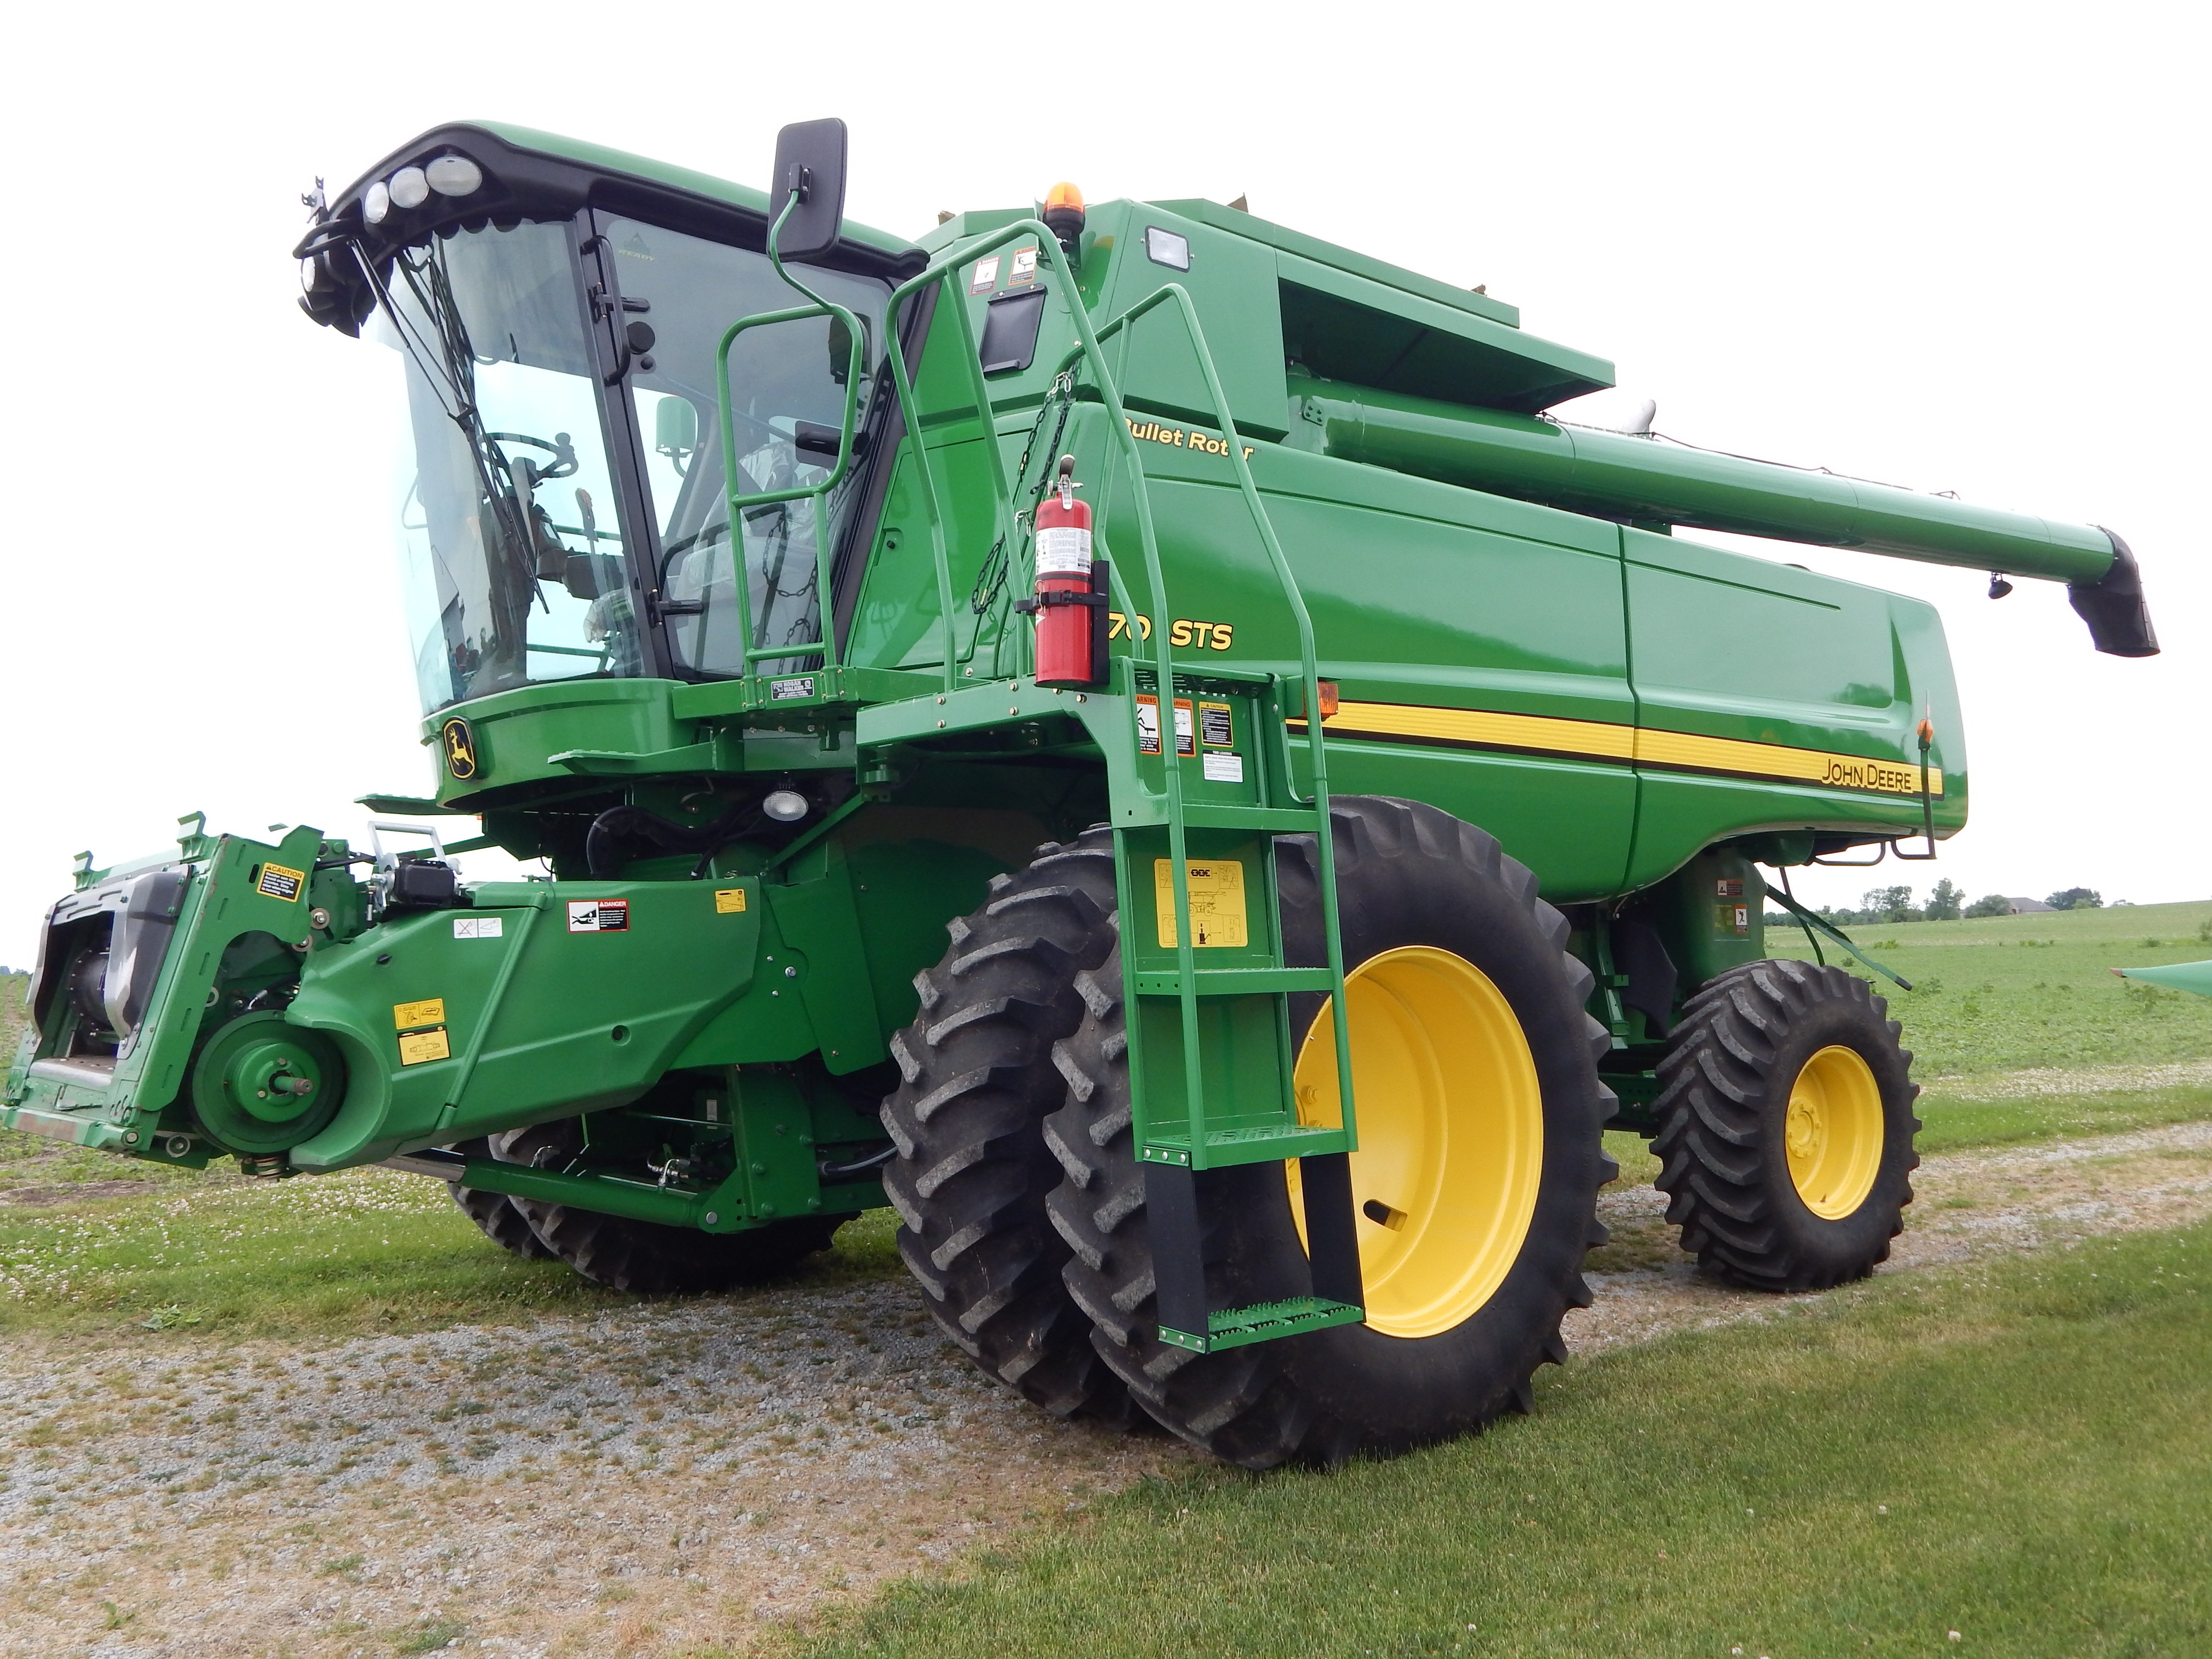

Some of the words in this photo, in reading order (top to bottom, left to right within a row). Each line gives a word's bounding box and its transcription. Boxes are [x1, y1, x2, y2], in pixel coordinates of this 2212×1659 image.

[619, 249, 655, 261] READY
[1187, 431, 1255, 461] Rotr
[1170, 619, 1234, 651] STS
[1822, 758, 1863, 784] JOHN
[1867, 764, 1911, 790] DEERE
[272, 866, 302, 878] CAUTION
